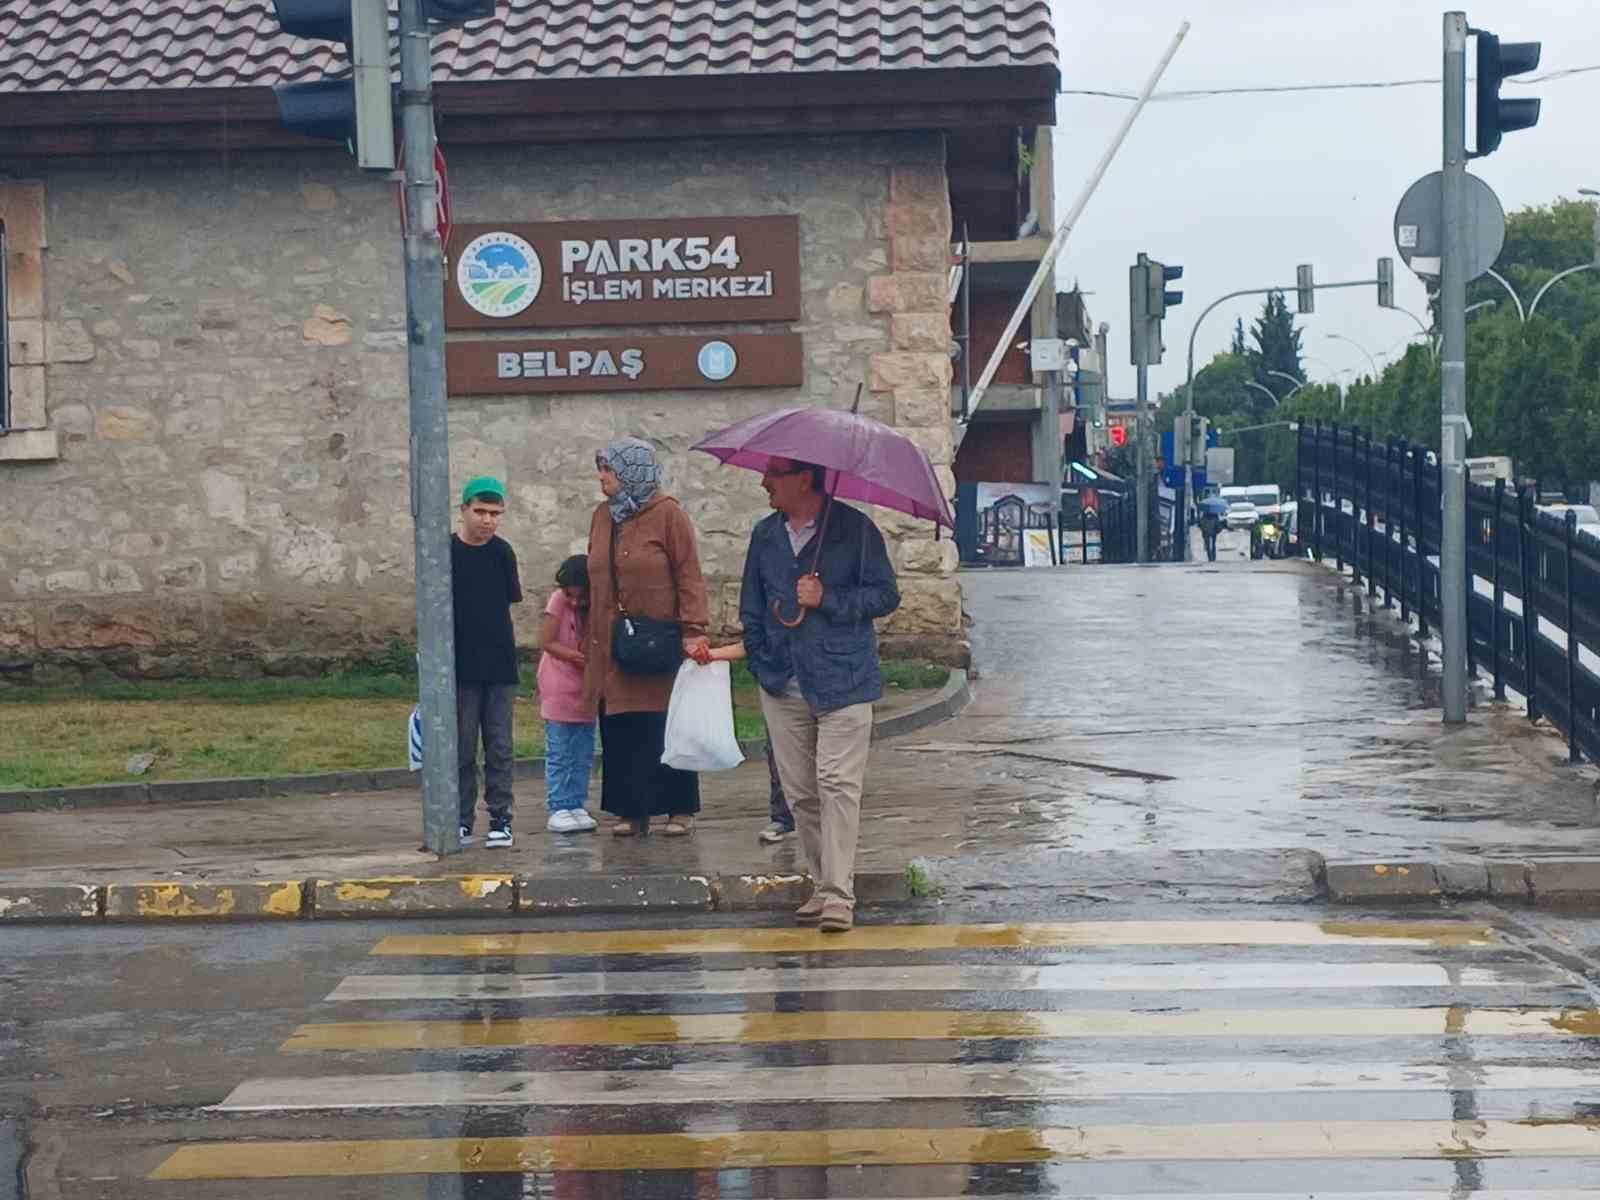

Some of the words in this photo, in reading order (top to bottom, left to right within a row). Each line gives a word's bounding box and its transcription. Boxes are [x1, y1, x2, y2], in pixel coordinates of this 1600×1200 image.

[561, 236, 739, 275] PARK54
[563, 276, 642, 304] İŞLEM
[652, 271, 772, 299] MERKEZİ
[497, 349, 644, 379] BELPAŞ
